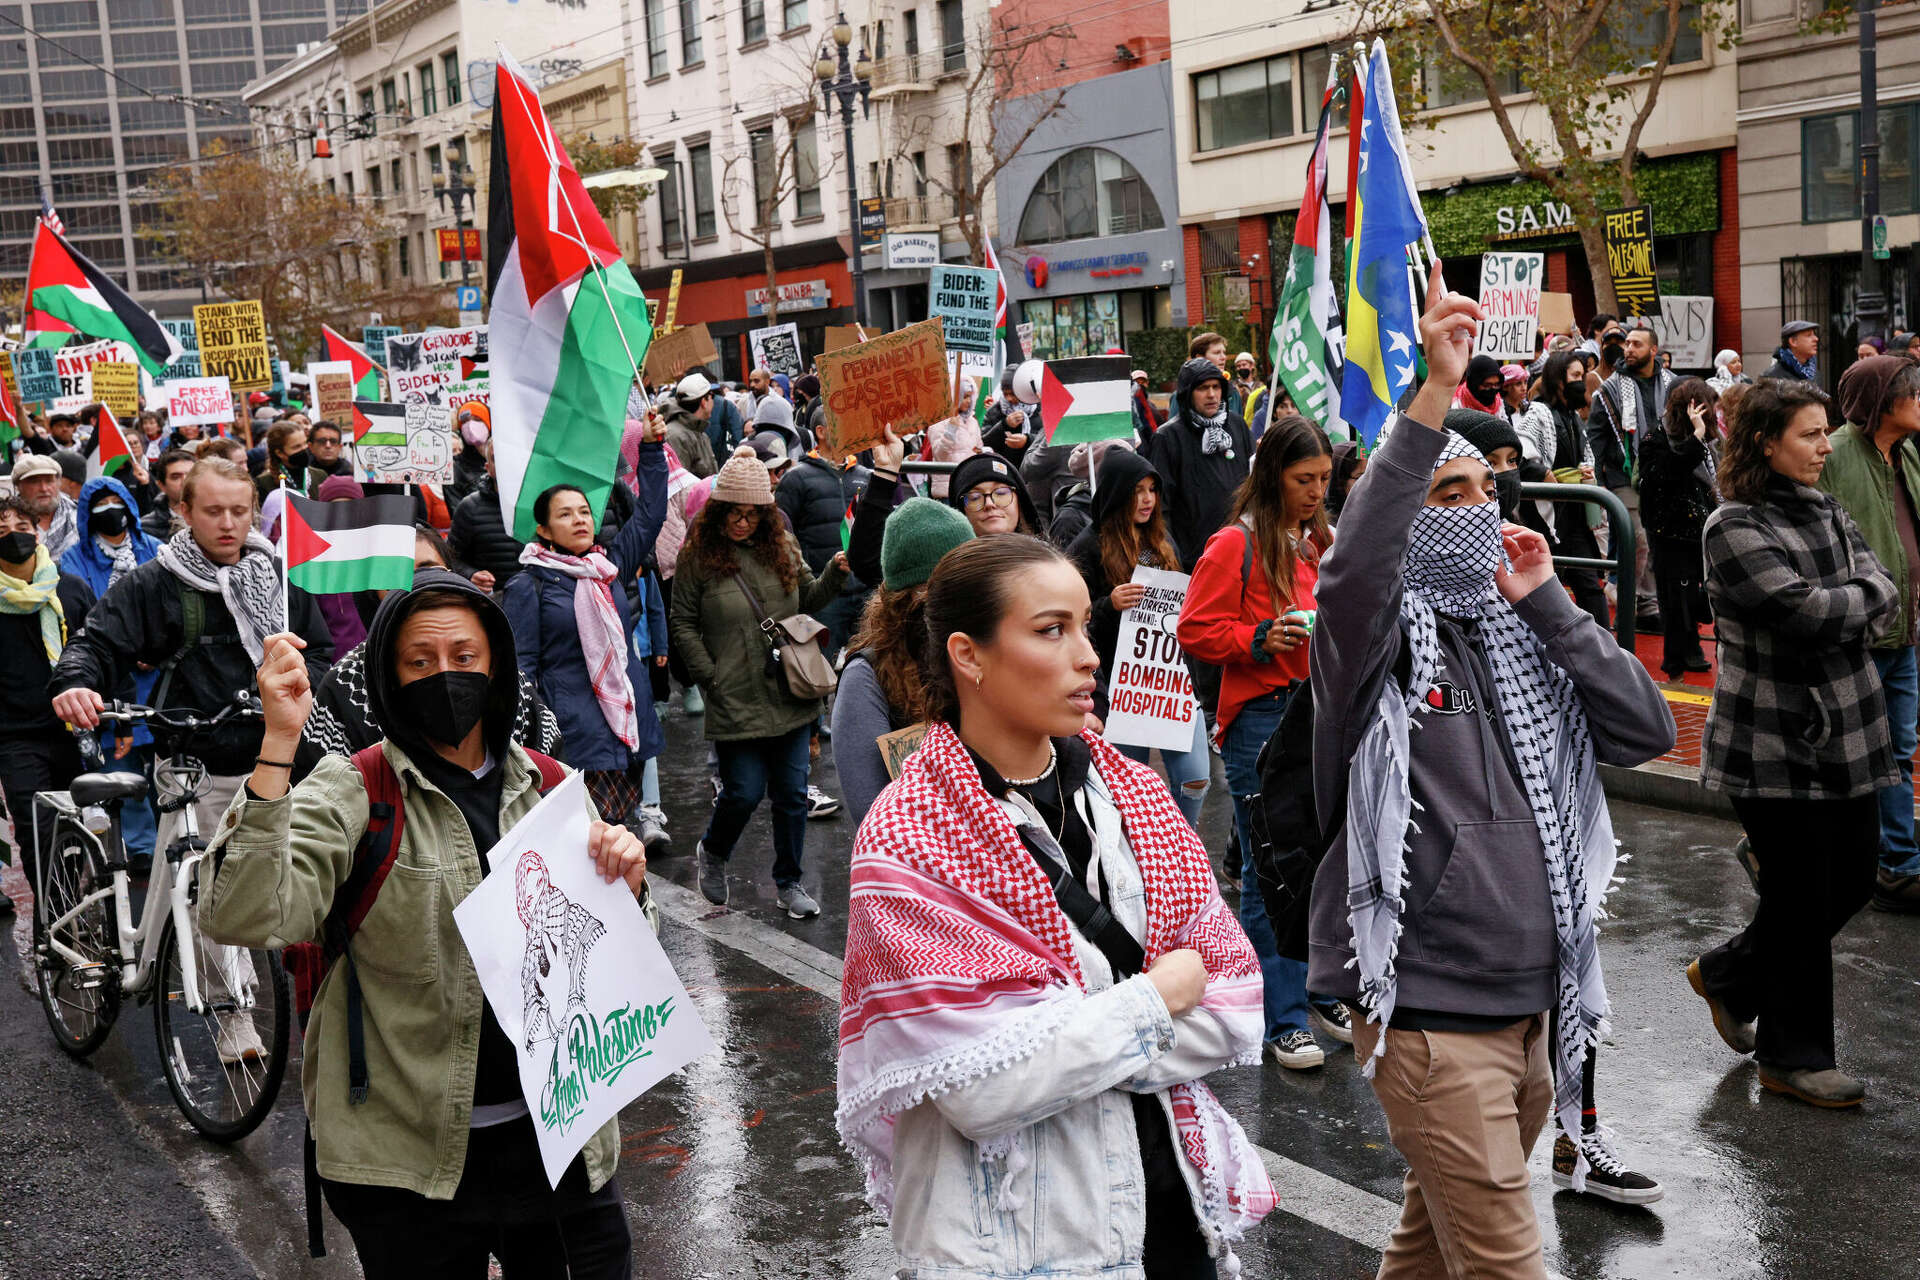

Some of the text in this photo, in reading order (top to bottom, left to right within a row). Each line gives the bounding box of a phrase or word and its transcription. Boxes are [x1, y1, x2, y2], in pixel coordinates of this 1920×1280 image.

[1496, 202, 1575, 234] SAM
[1606, 209, 1646, 240] FREE
[1607, 240, 1655, 278] PALESTINE
[942, 273, 986, 292] BIDEN:
[754, 287, 782, 304] LOCL
[936, 292, 989, 310] FUND THE
[1480, 288, 1539, 319] ARMING
[198, 303, 259, 318] STAND WITH
[200, 314, 260, 331] PALESTINE!
[968, 318, 992, 328] NEEDS
[202, 327, 262, 347] END THE
[423, 331, 473, 351] GENOCIDE
[949, 329, 991, 342] GENOCIDE
[1479, 319, 1534, 354] ISRAEL
[203, 346, 264, 361] OCCUPATION
[423, 353, 438, 364] YOU
[841, 338, 928, 383] PERMANENT
[206, 357, 266, 382] NOW!
[179, 385, 219, 398] FREE
[397, 373, 450, 392] BIDEN'S
[449, 393, 491, 408] PUSSY
[1136, 586, 1185, 604] EALTHCAR
[1129, 610, 1158, 626] DEMAND:
[1118, 661, 1193, 696] BOMBING
[1110, 688, 1193, 723] HOSPITALS
